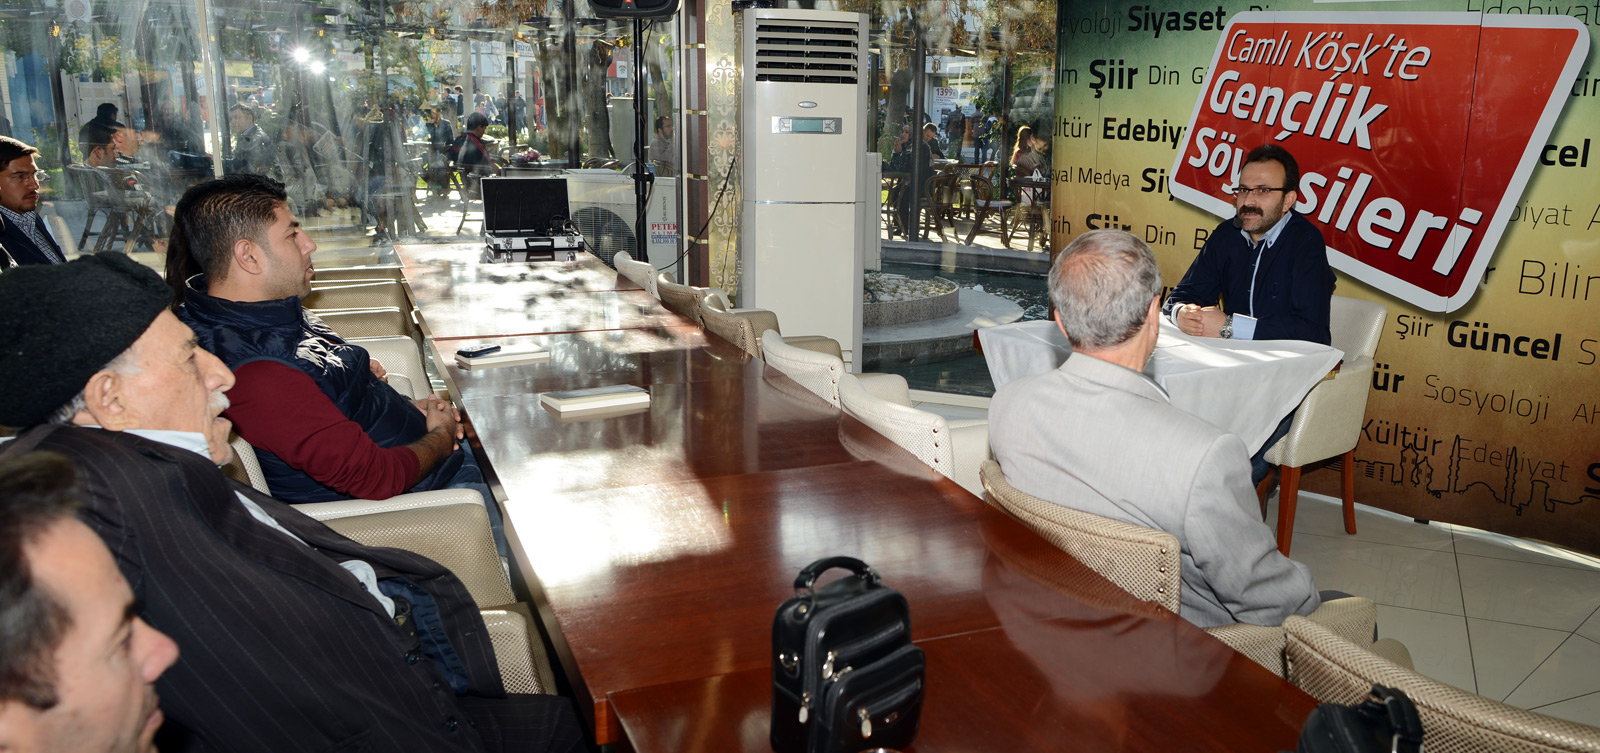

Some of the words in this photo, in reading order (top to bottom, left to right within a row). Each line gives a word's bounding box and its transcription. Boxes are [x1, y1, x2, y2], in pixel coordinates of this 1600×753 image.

[1128, 5, 1226, 39] Siyaset
[1294, 31, 1432, 81] Köşk'te
[1089, 59, 1139, 99] Şiir
[1149, 65, 1180, 85] Din
[1210, 70, 1389, 150] Gençlik
[1103, 117, 1187, 149] Edebiy
[1540, 138, 1591, 168] cel
[1078, 167, 1130, 191] Medya
[1051, 215, 1071, 235] rih
[1145, 224, 1176, 246] Din
[1396, 314, 1434, 340] Şiir
[1447, 320, 1562, 361] Güncel
[1424, 374, 1550, 425] Sosyoloji
[1361, 418, 1443, 456] Kültür
